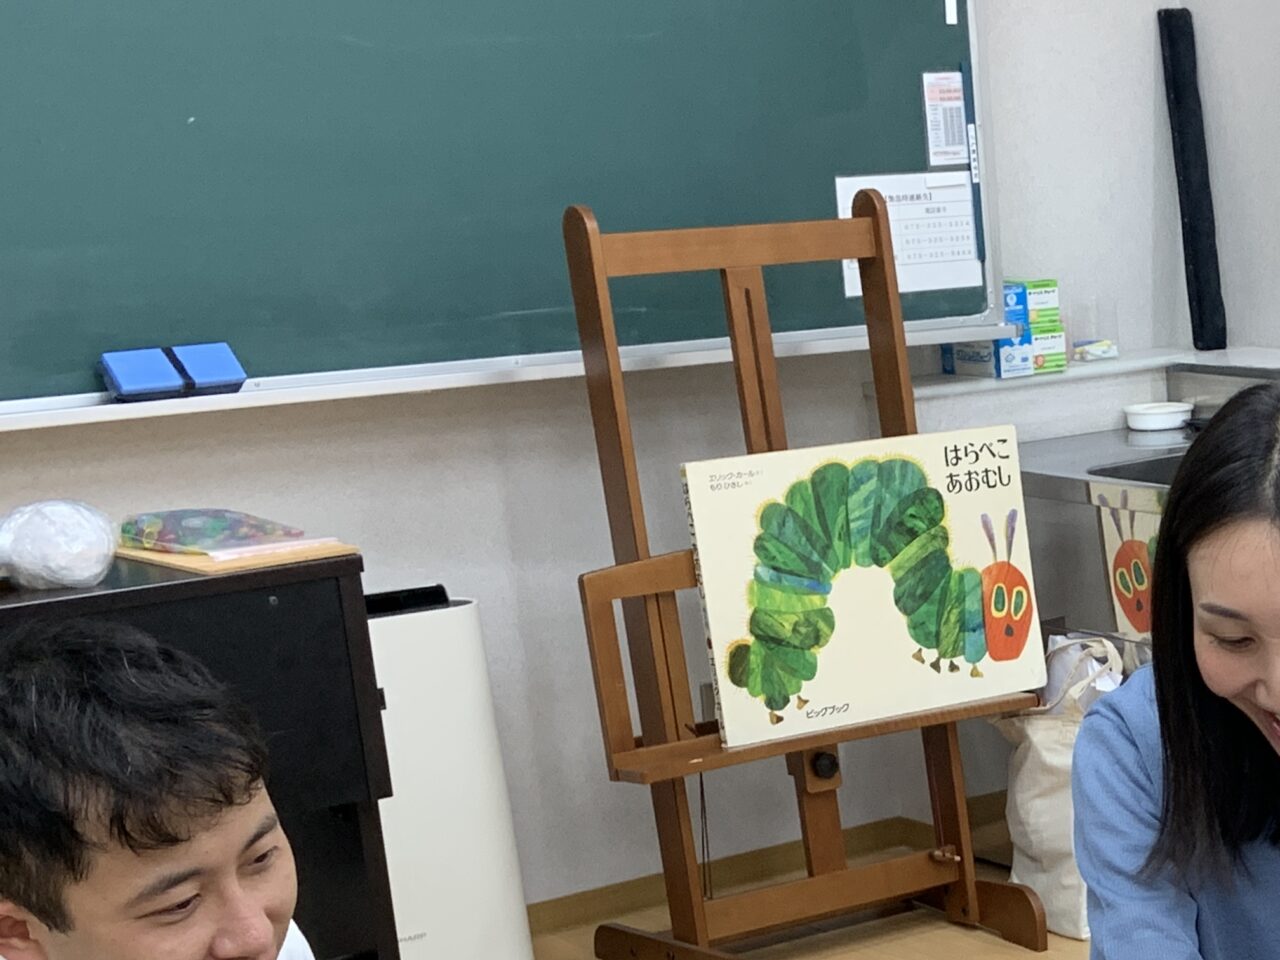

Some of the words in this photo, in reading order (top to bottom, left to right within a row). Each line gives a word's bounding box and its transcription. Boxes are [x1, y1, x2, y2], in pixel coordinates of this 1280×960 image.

[944, 438, 1010, 467] はらぺこ
[945, 465, 1011, 495] あおむし
[806, 703, 850, 719] ビッグブック
